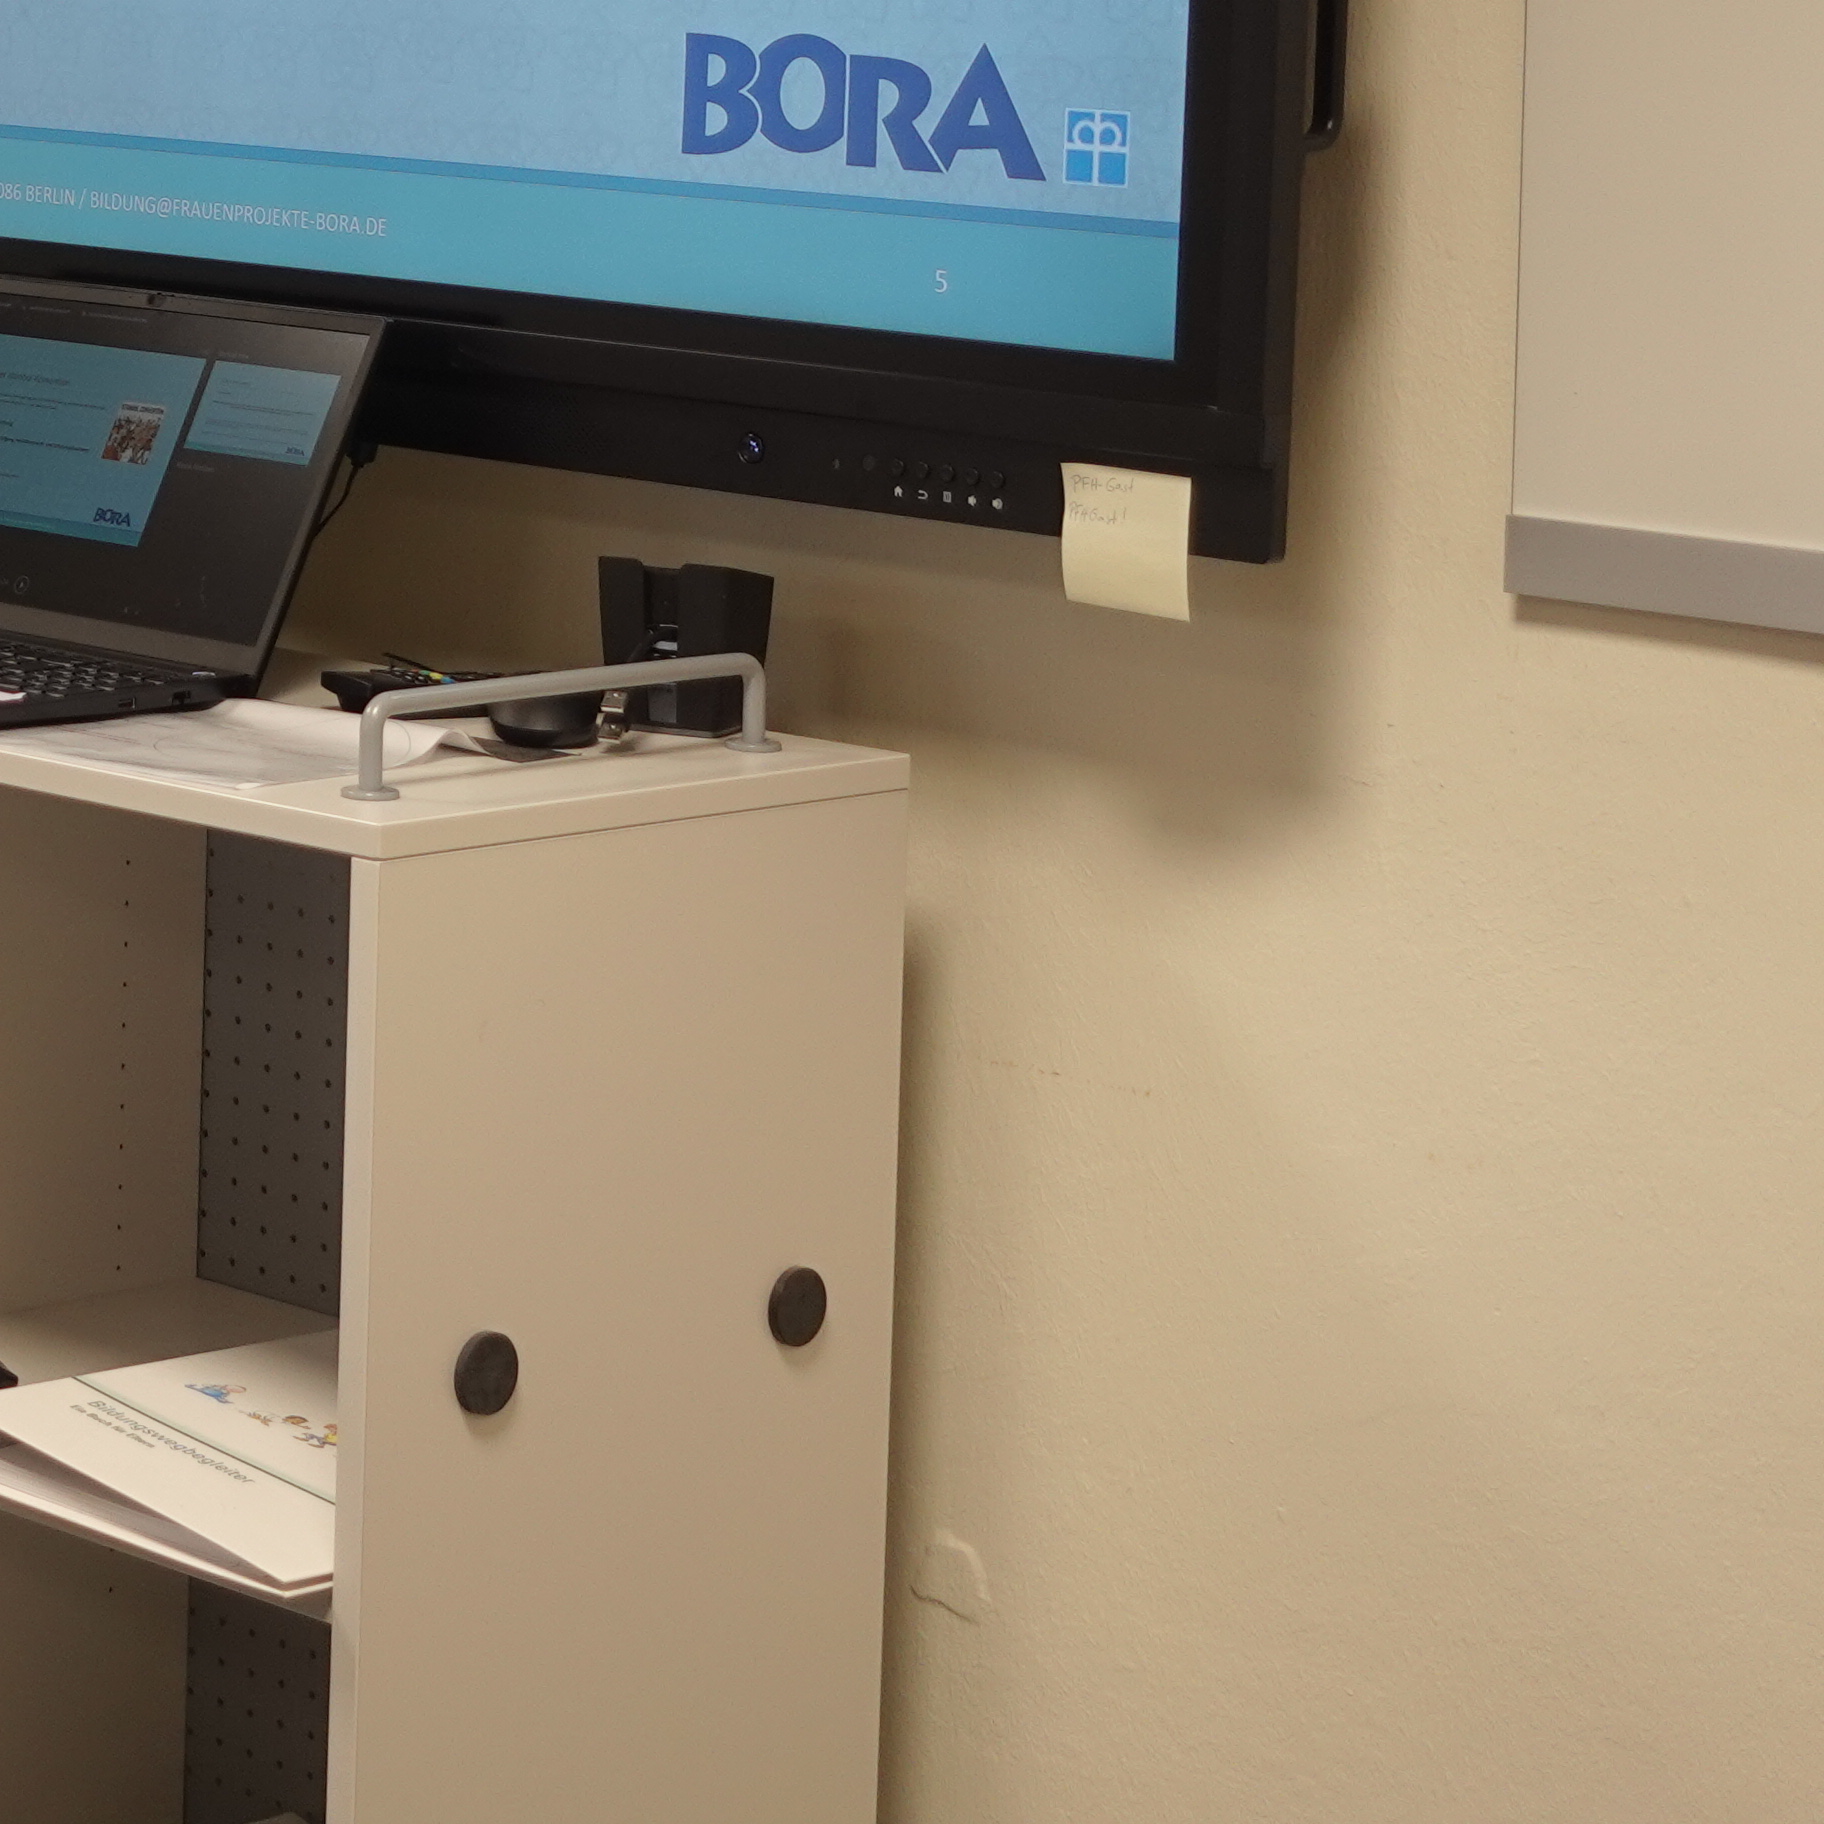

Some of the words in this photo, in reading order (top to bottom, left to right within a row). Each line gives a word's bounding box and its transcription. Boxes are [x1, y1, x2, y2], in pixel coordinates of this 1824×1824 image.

[681, 32, 1047, 182] BORA
[25, 185, 77, 207] BERLIN
[934, 270, 948, 294] 5
[93, 507, 131, 527] BORA
[87, 1400, 255, 1484] Bildungswegbegleiter
